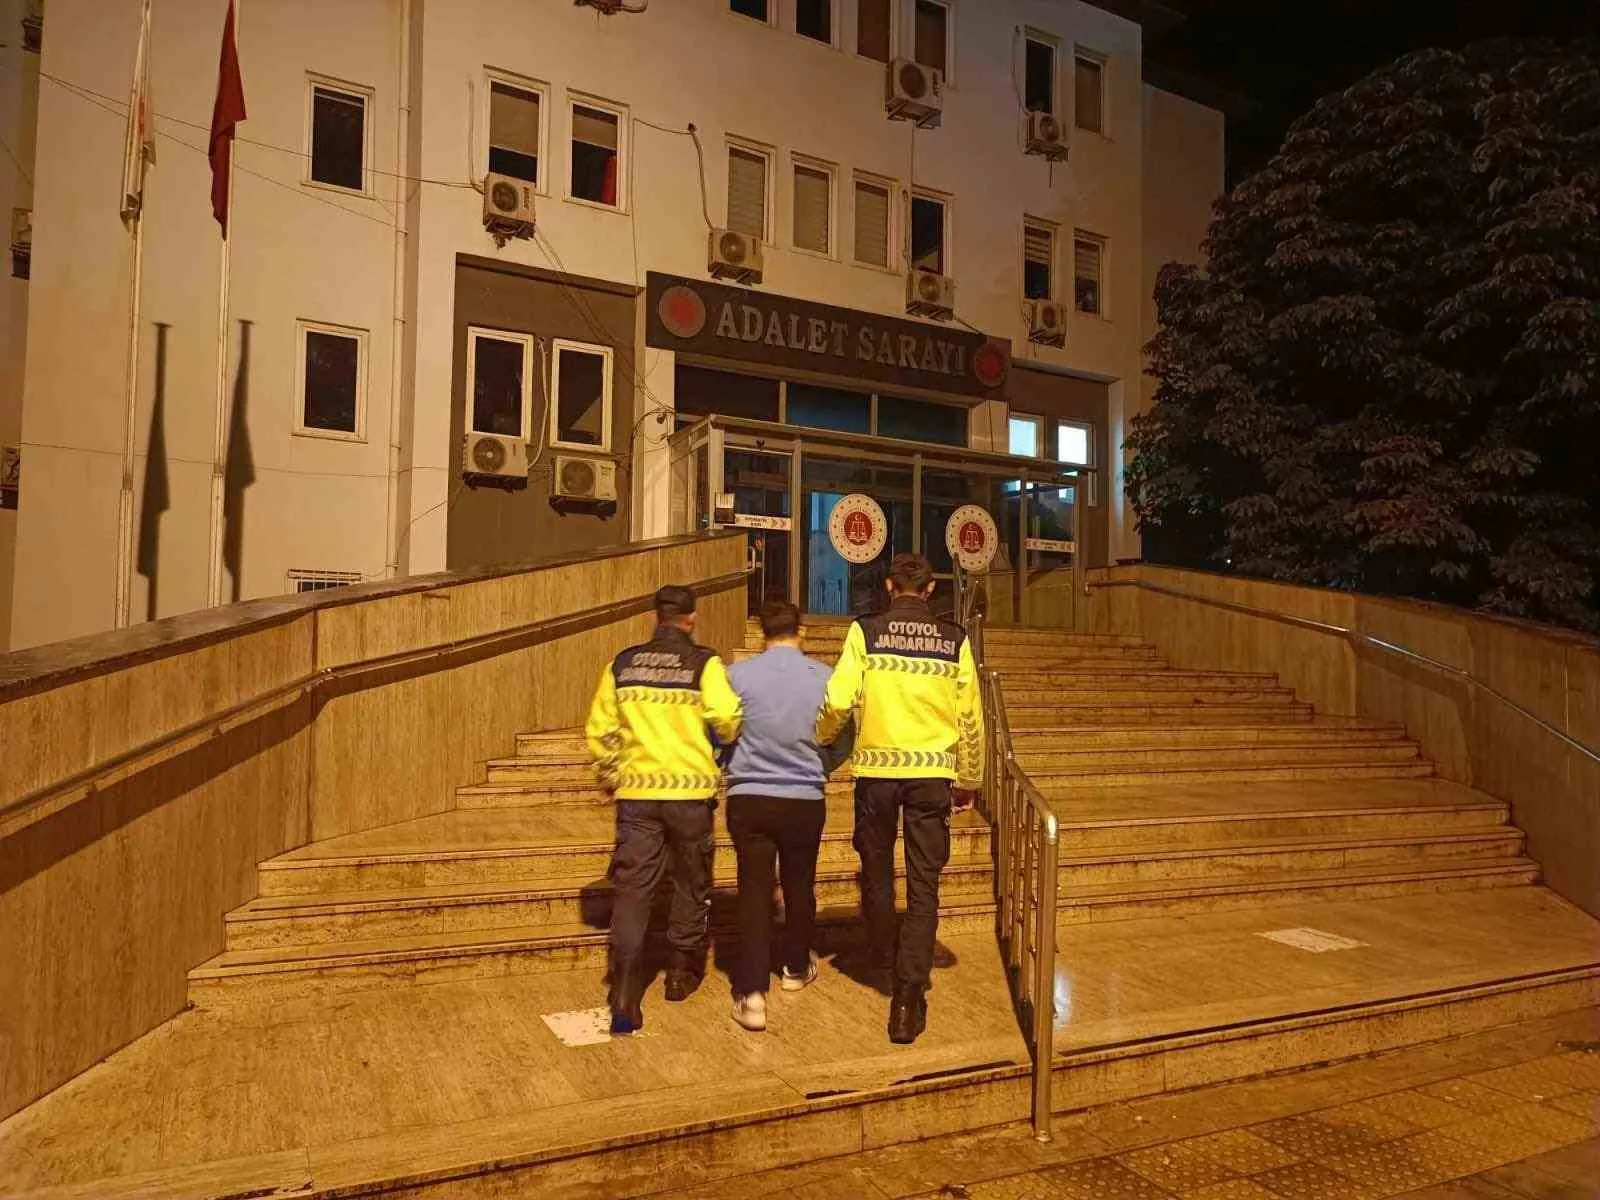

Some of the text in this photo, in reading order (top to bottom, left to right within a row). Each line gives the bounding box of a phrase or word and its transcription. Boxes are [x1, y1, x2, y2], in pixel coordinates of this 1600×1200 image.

[715, 301, 966, 376] ADALET SARAYI
[888, 621, 942, 637] OTOYOL
[874, 634, 955, 655] JANDARMASI
